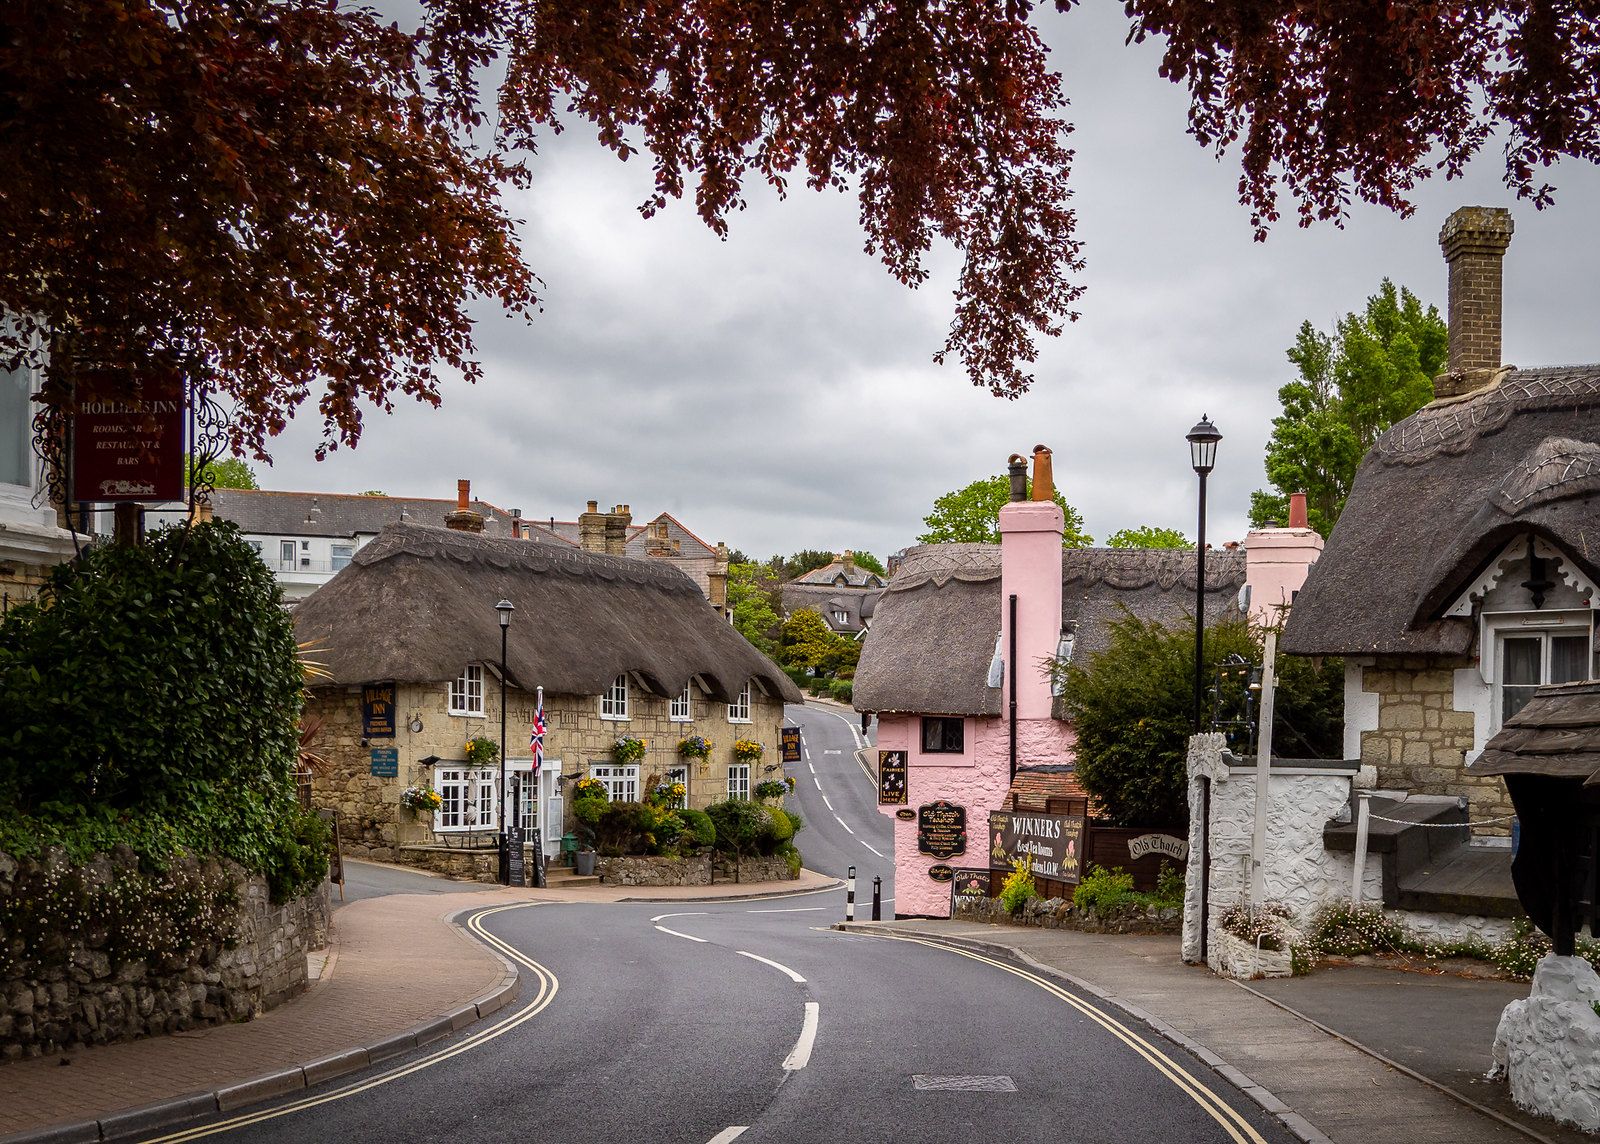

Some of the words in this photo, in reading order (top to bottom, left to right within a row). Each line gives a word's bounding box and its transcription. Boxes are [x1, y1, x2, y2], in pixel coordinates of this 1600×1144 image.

[153, 401, 177, 413] INN
[117, 457, 139, 465] BARS
[366, 688, 392, 705] VILLAGE
[373, 703, 385, 714] INN
[1012, 816, 1061, 839] WINNERS
[1017, 839, 1029, 853] Best
[1029, 840, 1038, 855] Tea
[1132, 838, 1150, 855] Old
[1151, 836, 1183, 857] Thatch
[1027, 858, 1043, 874] ardens
[955, 872, 969, 881] Old
